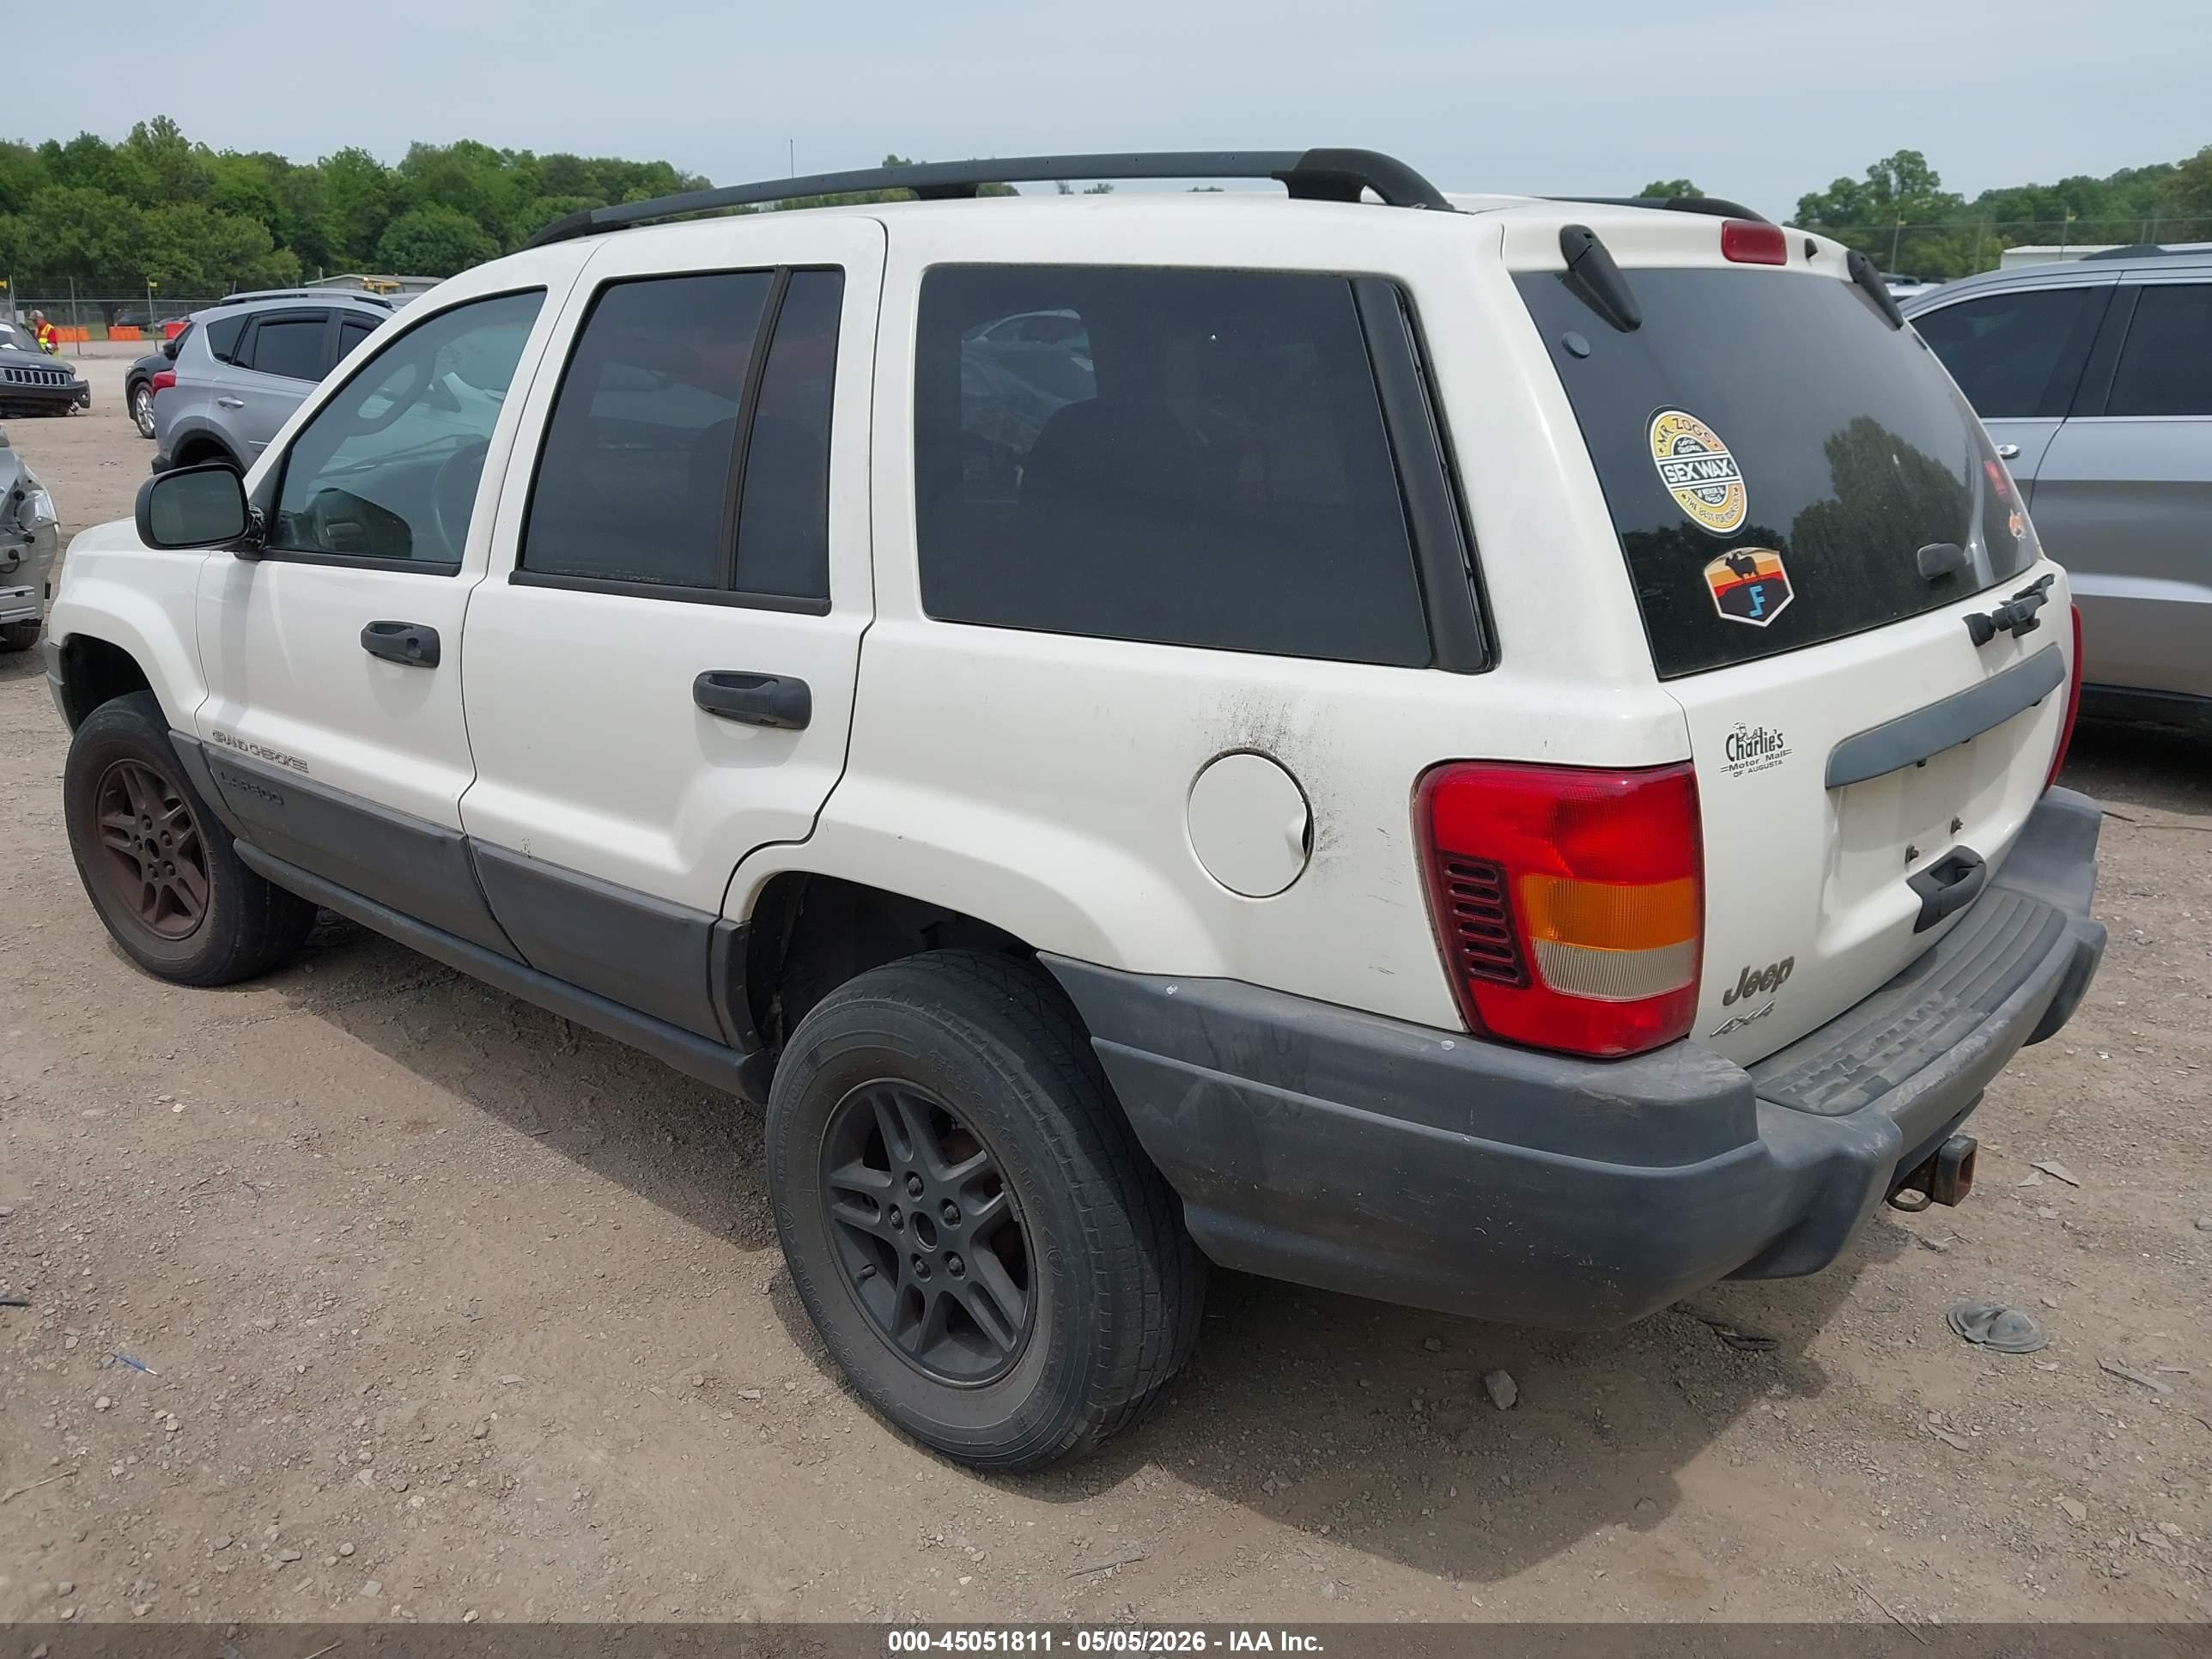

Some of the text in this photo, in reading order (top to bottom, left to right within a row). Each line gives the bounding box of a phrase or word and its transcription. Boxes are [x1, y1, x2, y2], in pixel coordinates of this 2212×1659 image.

[1672, 417, 1711, 443] ZOGS
[1663, 459, 1735, 483] SEX WAX
[1686, 495, 1698, 511] THE
[1725, 726, 1784, 763] Charlie's
[1729, 750, 1787, 772] Motor Mall
[1733, 758, 1784, 778] OF AUGUSTA
[1722, 955, 1796, 1006] Jeep
